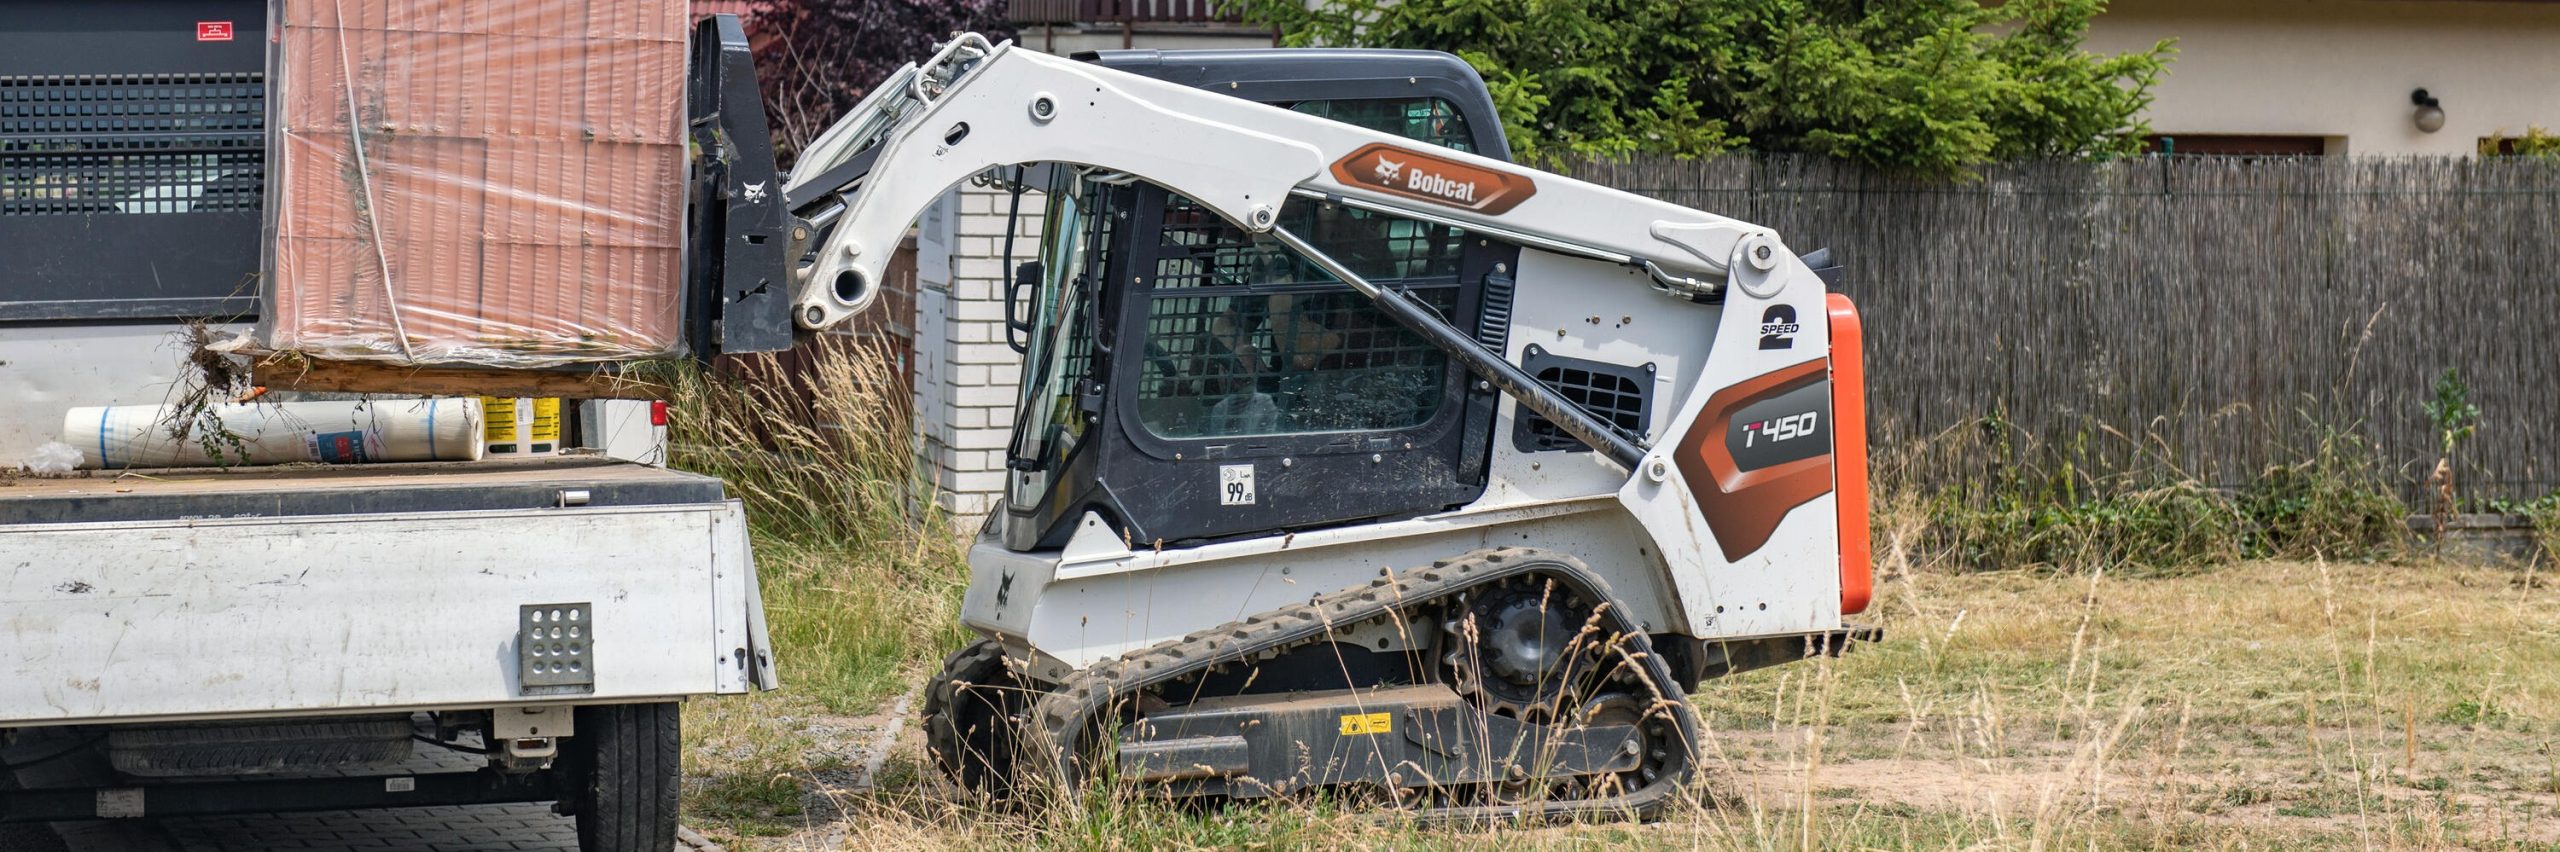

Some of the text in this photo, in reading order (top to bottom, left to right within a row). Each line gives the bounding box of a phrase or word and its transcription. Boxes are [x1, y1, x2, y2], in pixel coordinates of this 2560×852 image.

[1408, 168, 1475, 202] Bobcat
[1759, 304, 1799, 350] 2 SPEED
[1742, 411, 1817, 448] T450
[1228, 482, 1243, 502] 99
